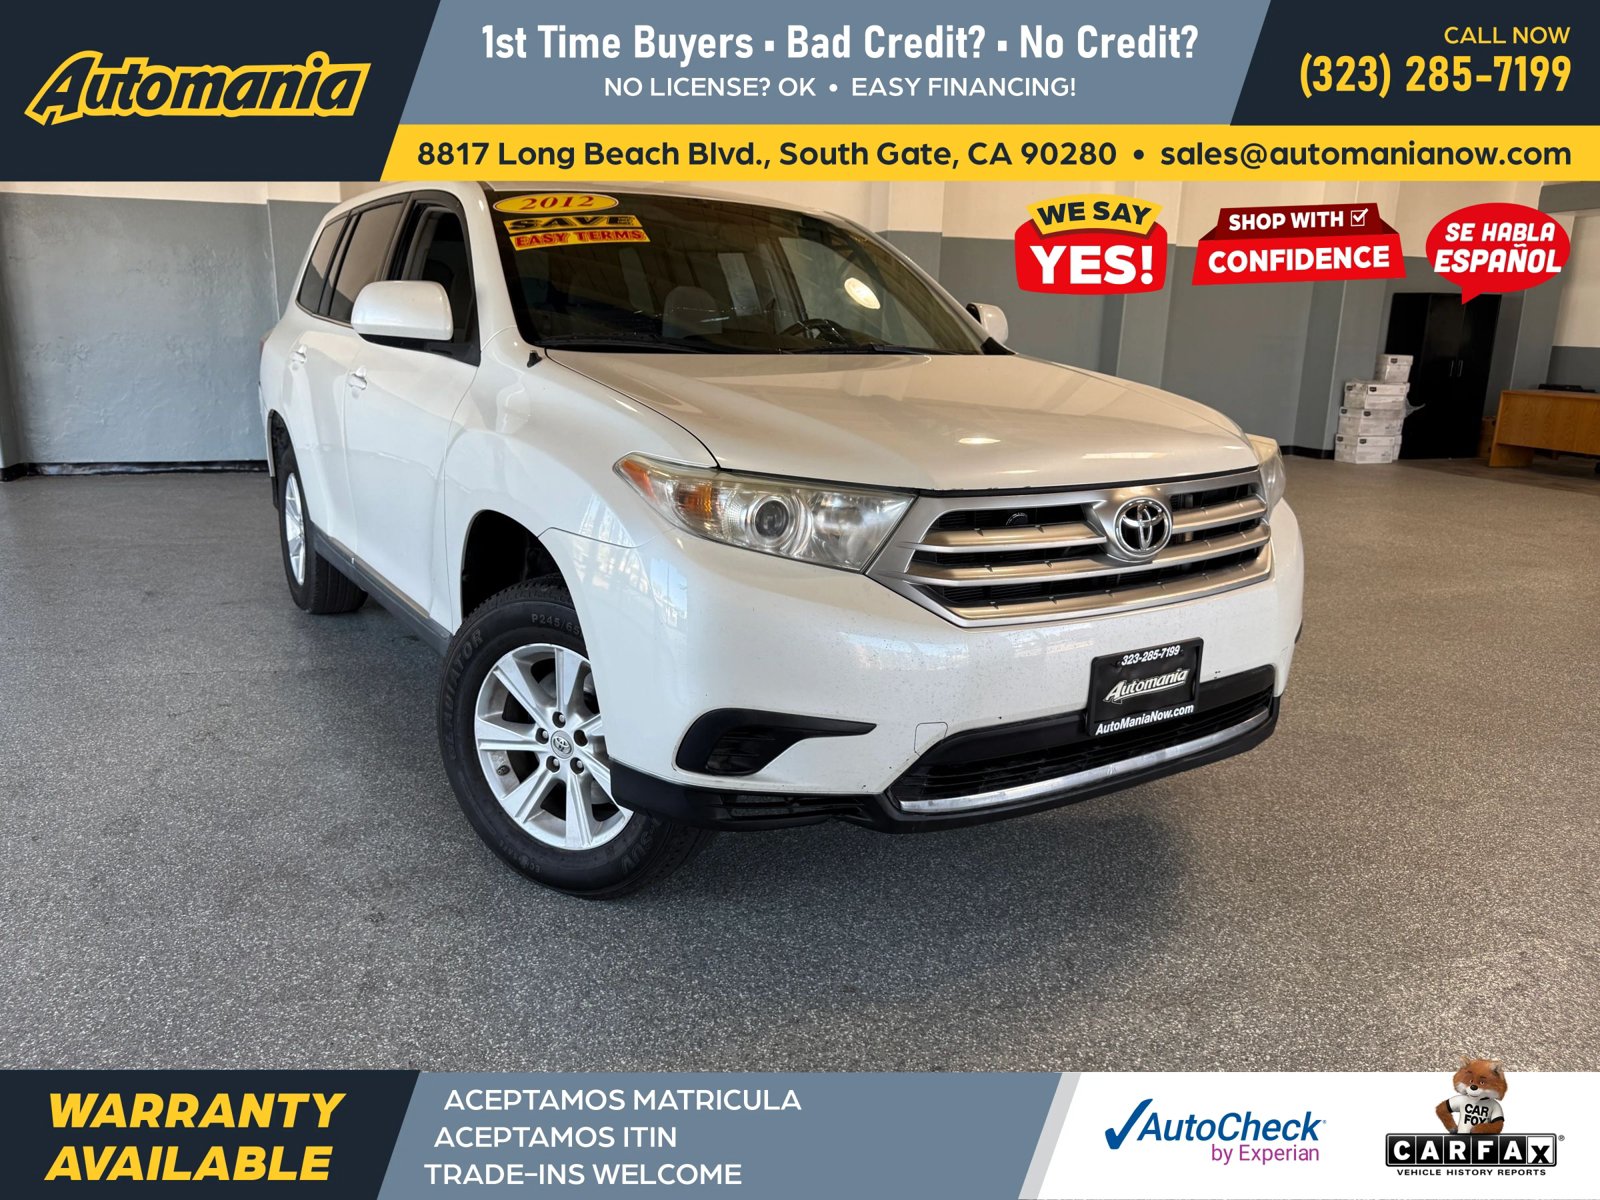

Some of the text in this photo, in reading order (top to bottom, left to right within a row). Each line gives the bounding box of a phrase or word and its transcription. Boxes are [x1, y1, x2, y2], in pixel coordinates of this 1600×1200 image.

[520, 195, 594, 210] 2012
[509, 216, 634, 231] SAVE
[515, 230, 646, 247] EASY TERMS
[1121, 645, 1181, 666] 323-285-7199
[1104, 668, 1190, 704] Automania
[1095, 704, 1194, 735] AutoManiaNow.com
